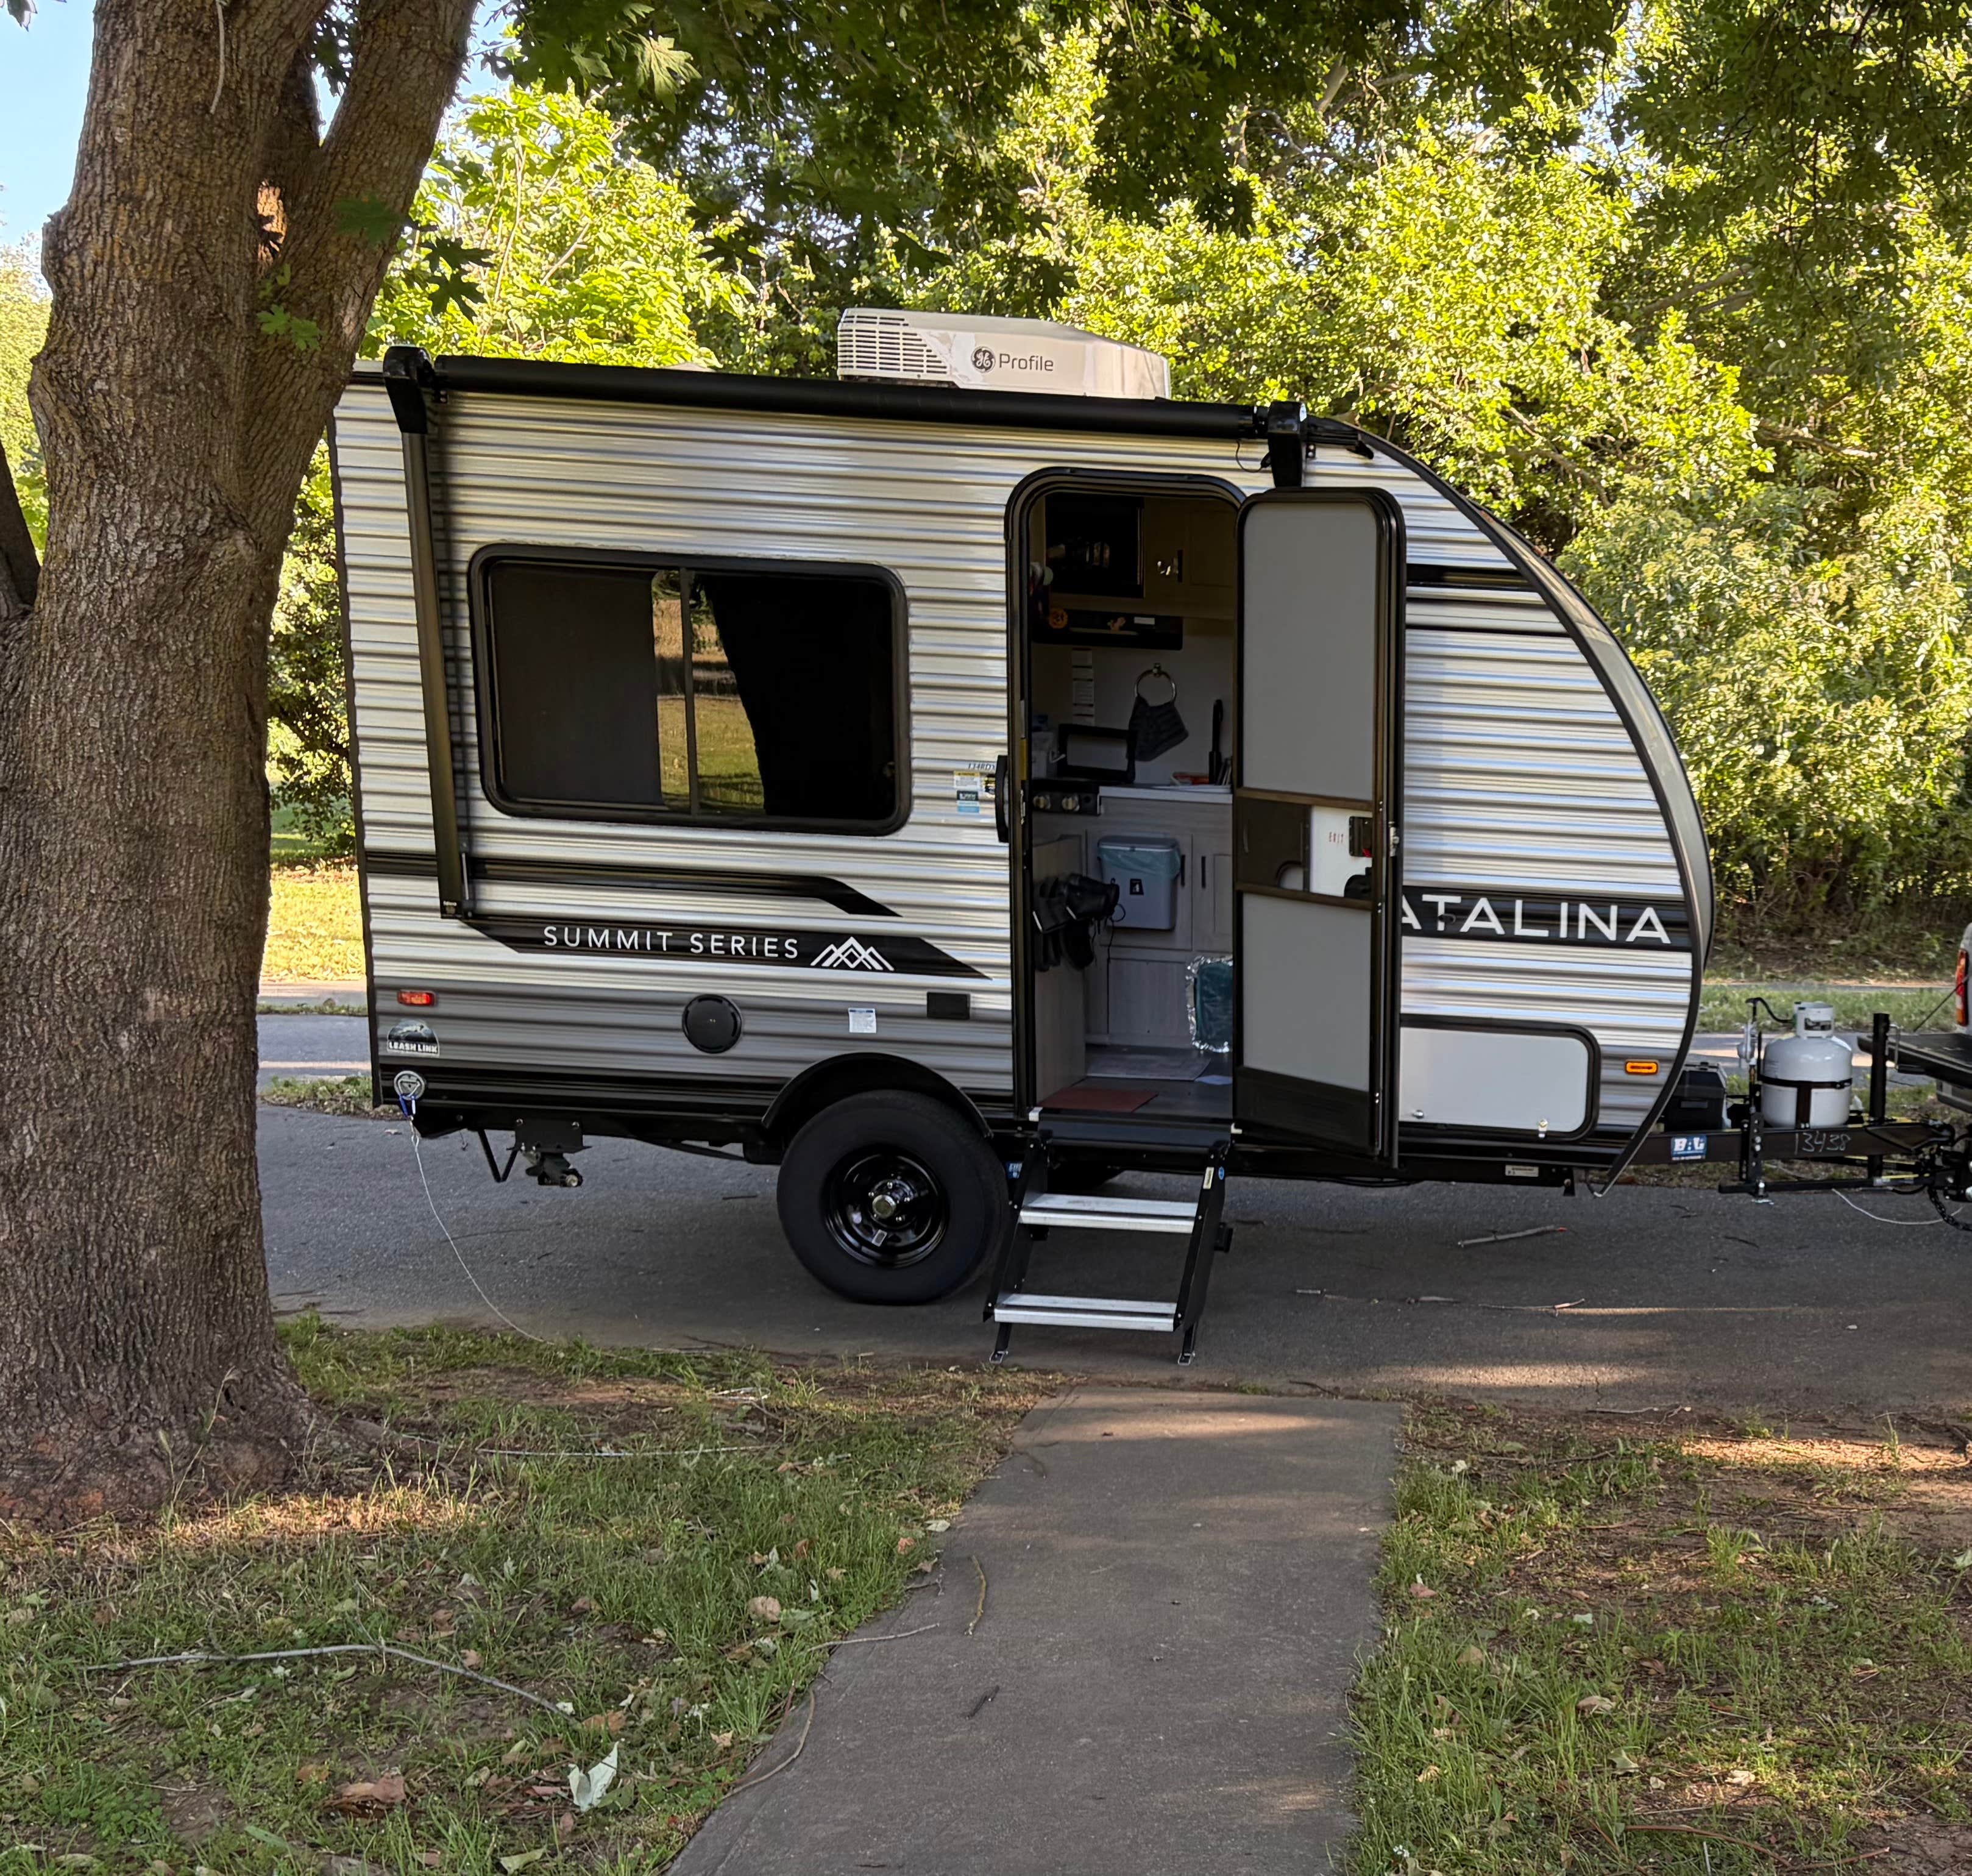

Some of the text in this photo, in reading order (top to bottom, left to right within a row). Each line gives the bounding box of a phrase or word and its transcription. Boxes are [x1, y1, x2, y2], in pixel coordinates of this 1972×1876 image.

[999, 353, 1054, 371] Profile
[544, 926, 798, 959] SUMMIT SERIES
[389, 1041, 438, 1053] LEASH LINK
[1794, 1130, 1851, 1156] 13438
